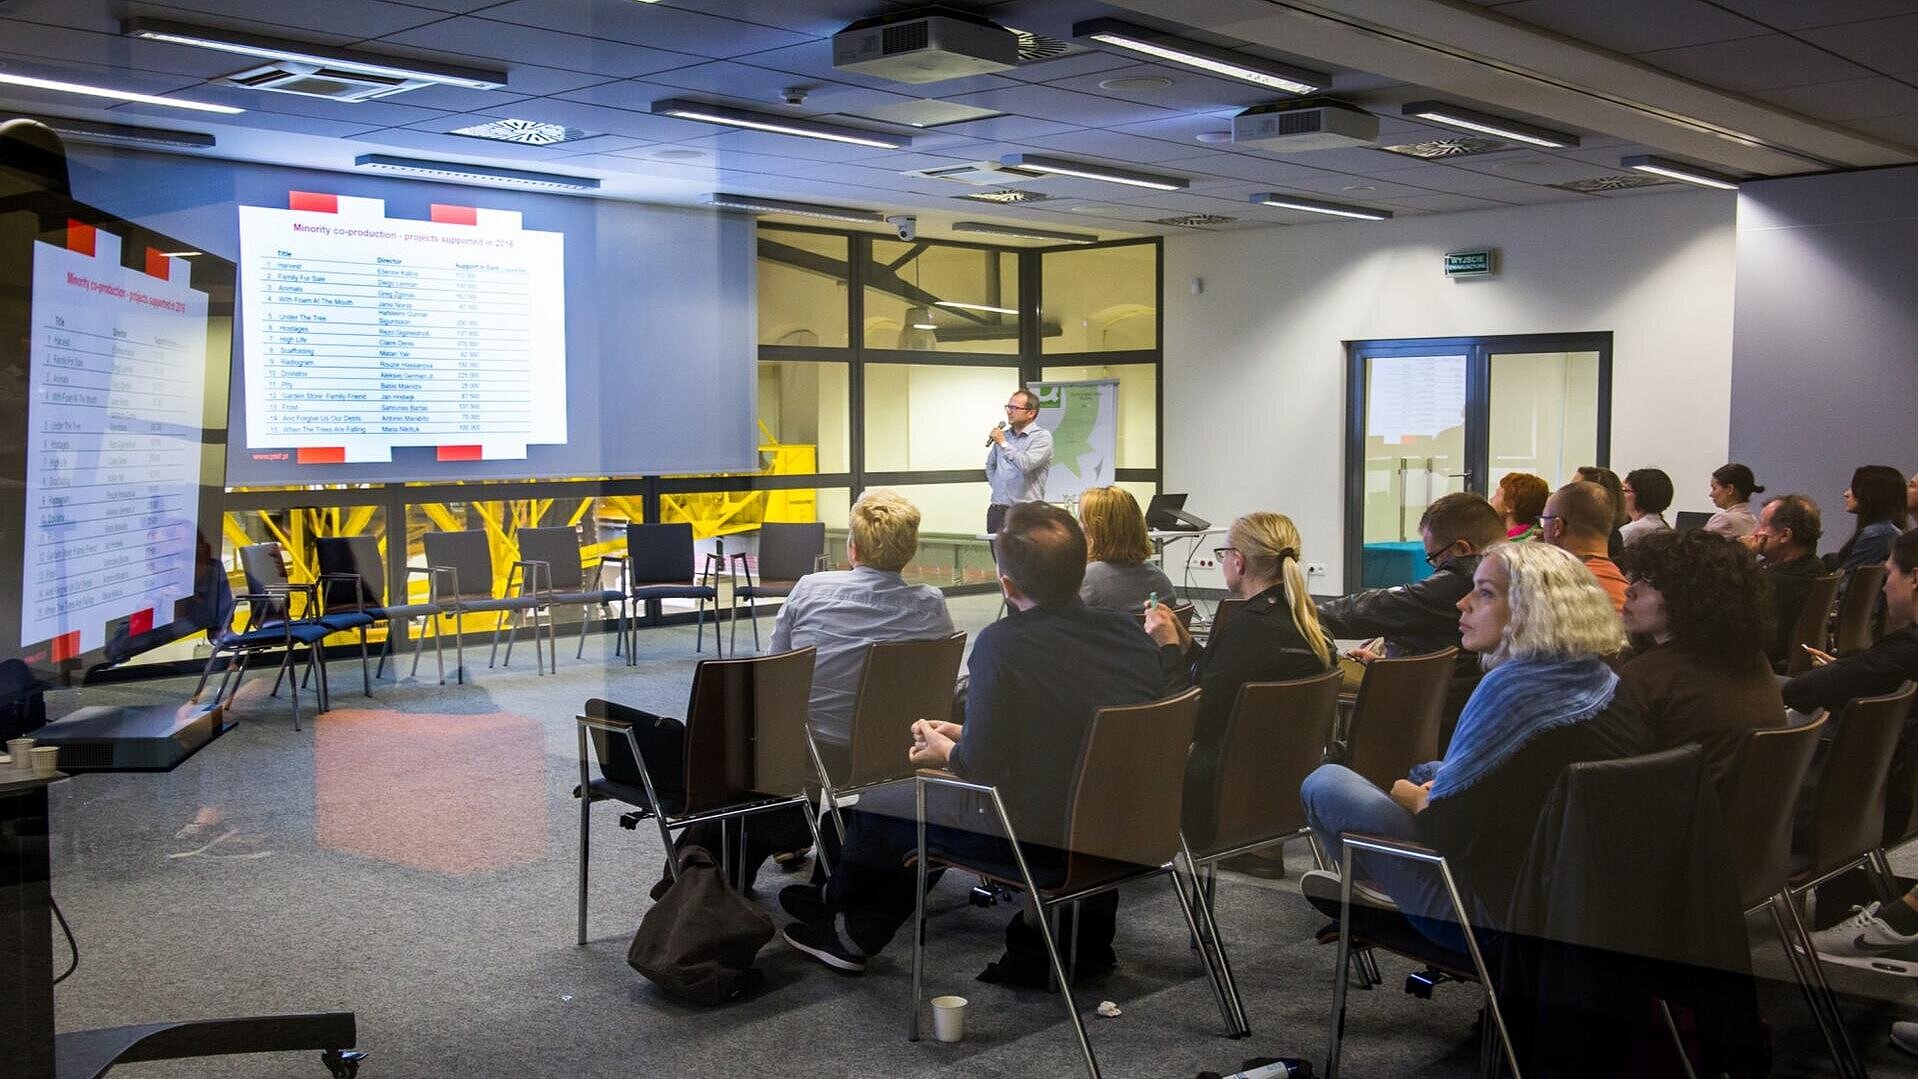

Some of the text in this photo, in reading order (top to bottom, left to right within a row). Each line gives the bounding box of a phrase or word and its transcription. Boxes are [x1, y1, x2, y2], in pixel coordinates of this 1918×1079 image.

[294, 223, 330, 236] Minority
[333, 228, 397, 239] co-production
[404, 232, 439, 244] projects
[377, 256, 402, 265] Director
